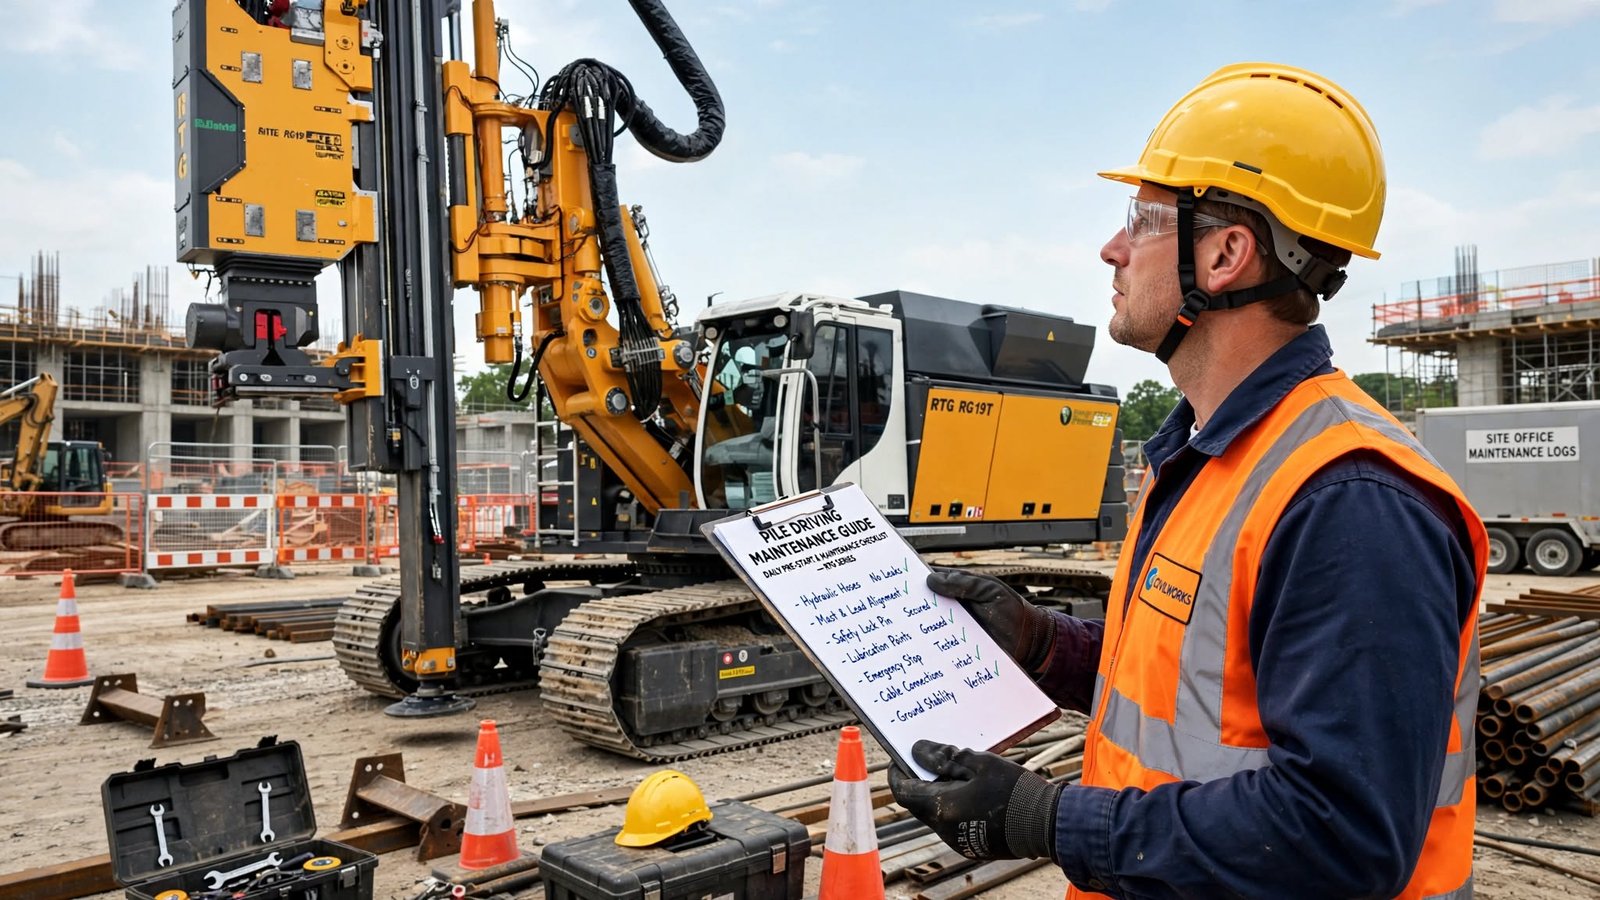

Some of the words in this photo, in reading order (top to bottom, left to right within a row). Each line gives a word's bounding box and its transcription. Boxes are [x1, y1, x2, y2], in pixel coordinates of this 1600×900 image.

[930, 397, 955, 412] RTG
[958, 399, 994, 416] RG19T
[1468, 446, 1544, 459] MAINTENANCE
[1547, 445, 1577, 457] LOGS
[1486, 432, 1510, 444] SITE
[1514, 431, 1554, 443] OFFICE
[748, 529, 839, 566] MAINTENANCE
[837, 517, 876, 538] GUIDE
[758, 525, 792, 543] PILE
[788, 509, 843, 535] DRIVING
[762, 566, 782, 579] DAILY
[781, 555, 815, 573] PRE-START
[819, 540, 861, 559] MAINTENANCE
[859, 531, 889, 547] CHECKLIST
[835, 554, 857, 566] SERIES
[799, 587, 839, 610] Hydraulic
[837, 581, 862, 594] Hoses
[869, 571, 882, 583] No
[880, 565, 903, 579] Leaks
[815, 610, 839, 626] Mast
[838, 608, 847, 618] &
[846, 599, 867, 615] Lead
[866, 586, 902, 609] Alignment
[831, 628, 862, 645] Safety
[858, 619, 880, 634] Lock
[876, 615, 893, 627] Pin
[902, 598, 931, 617] Secured
[846, 642, 890, 664] Lubrication
[887, 631, 913, 647] Points
[919, 615, 948, 635] Greased
[863, 662, 907, 683] Emergency
[902, 653, 924, 667] Stop
[933, 634, 960, 652] Tested
[879, 685, 904, 703] Cable
[902, 669, 944, 692] Connections
[896, 700, 925, 722] Ground
[923, 690, 958, 709] Stability
[963, 667, 994, 689] Verified
